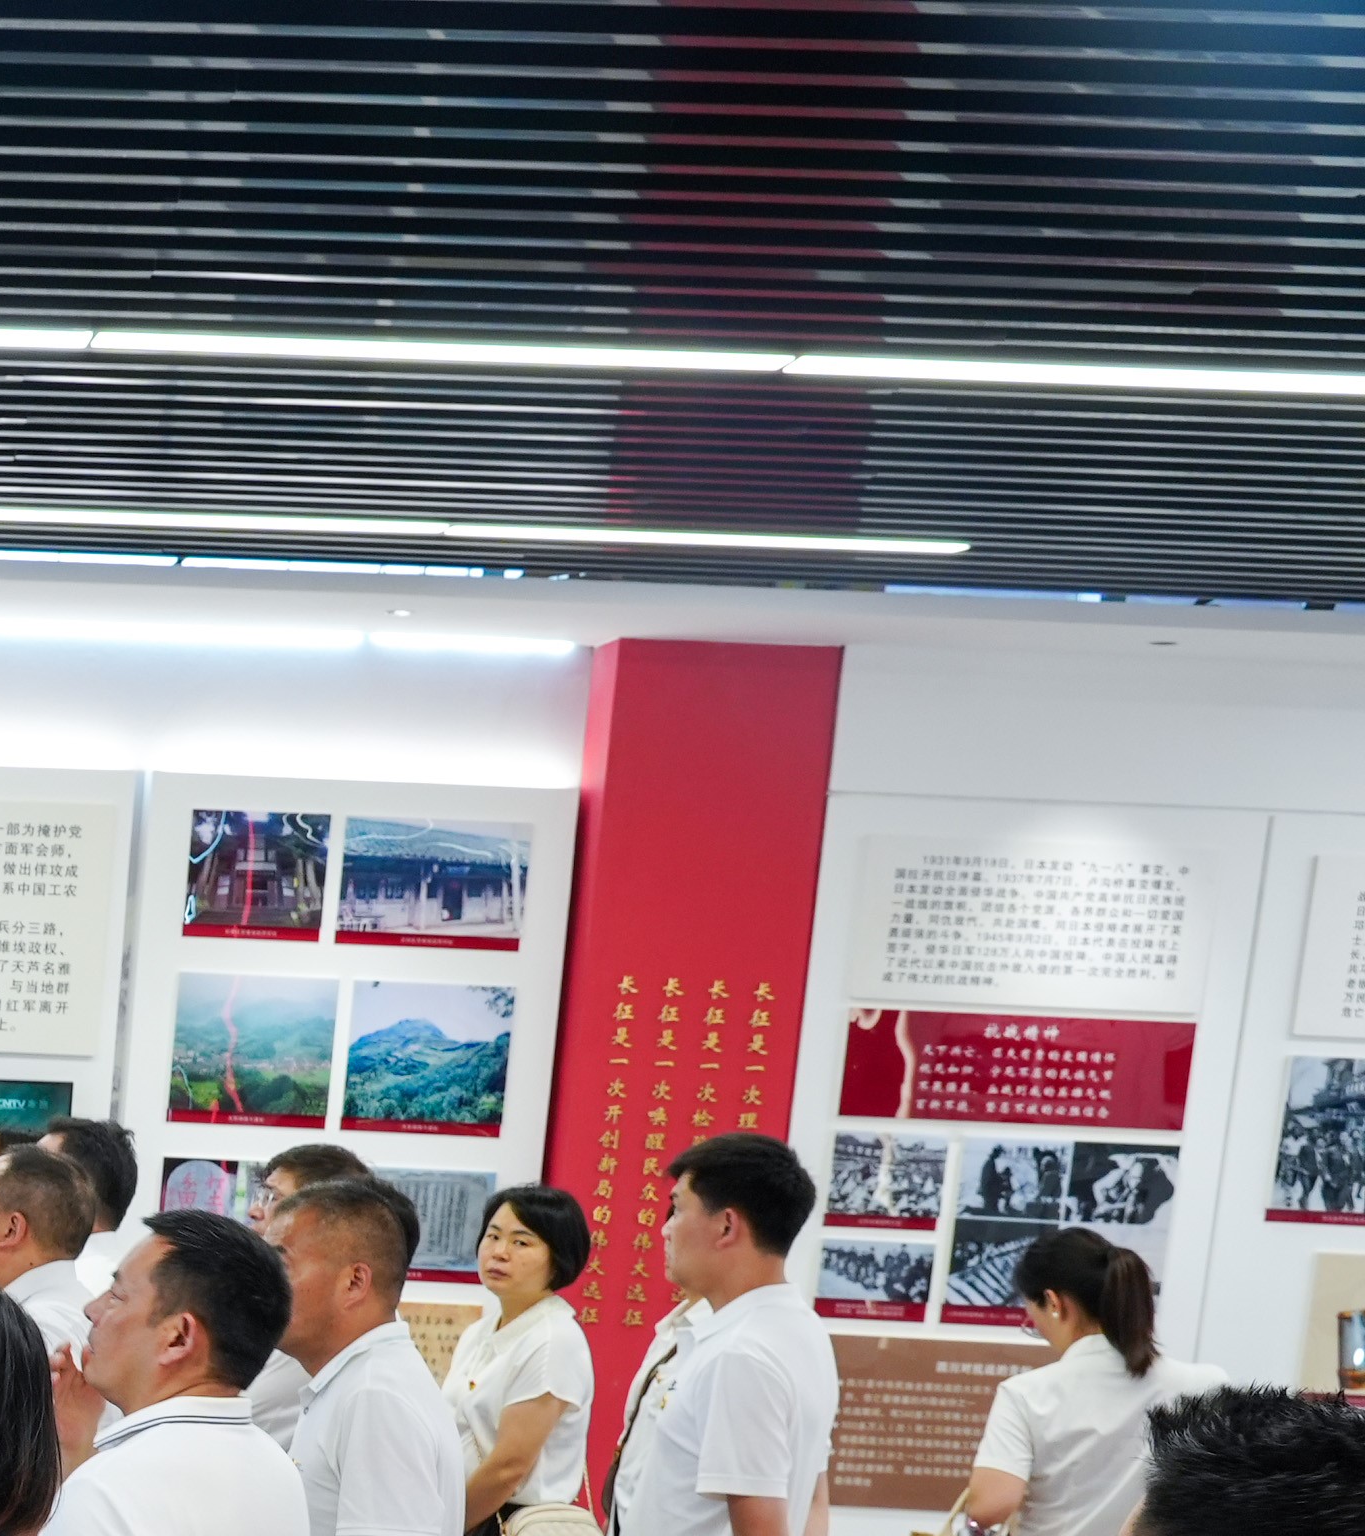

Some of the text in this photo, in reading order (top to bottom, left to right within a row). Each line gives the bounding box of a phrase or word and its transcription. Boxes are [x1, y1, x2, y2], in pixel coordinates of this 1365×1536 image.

[579, 975, 639, 1324] 长征是一次开创新局的伟大远征
[623, 977, 685, 1327] 长征是一次唤醒民众的伟大远征
